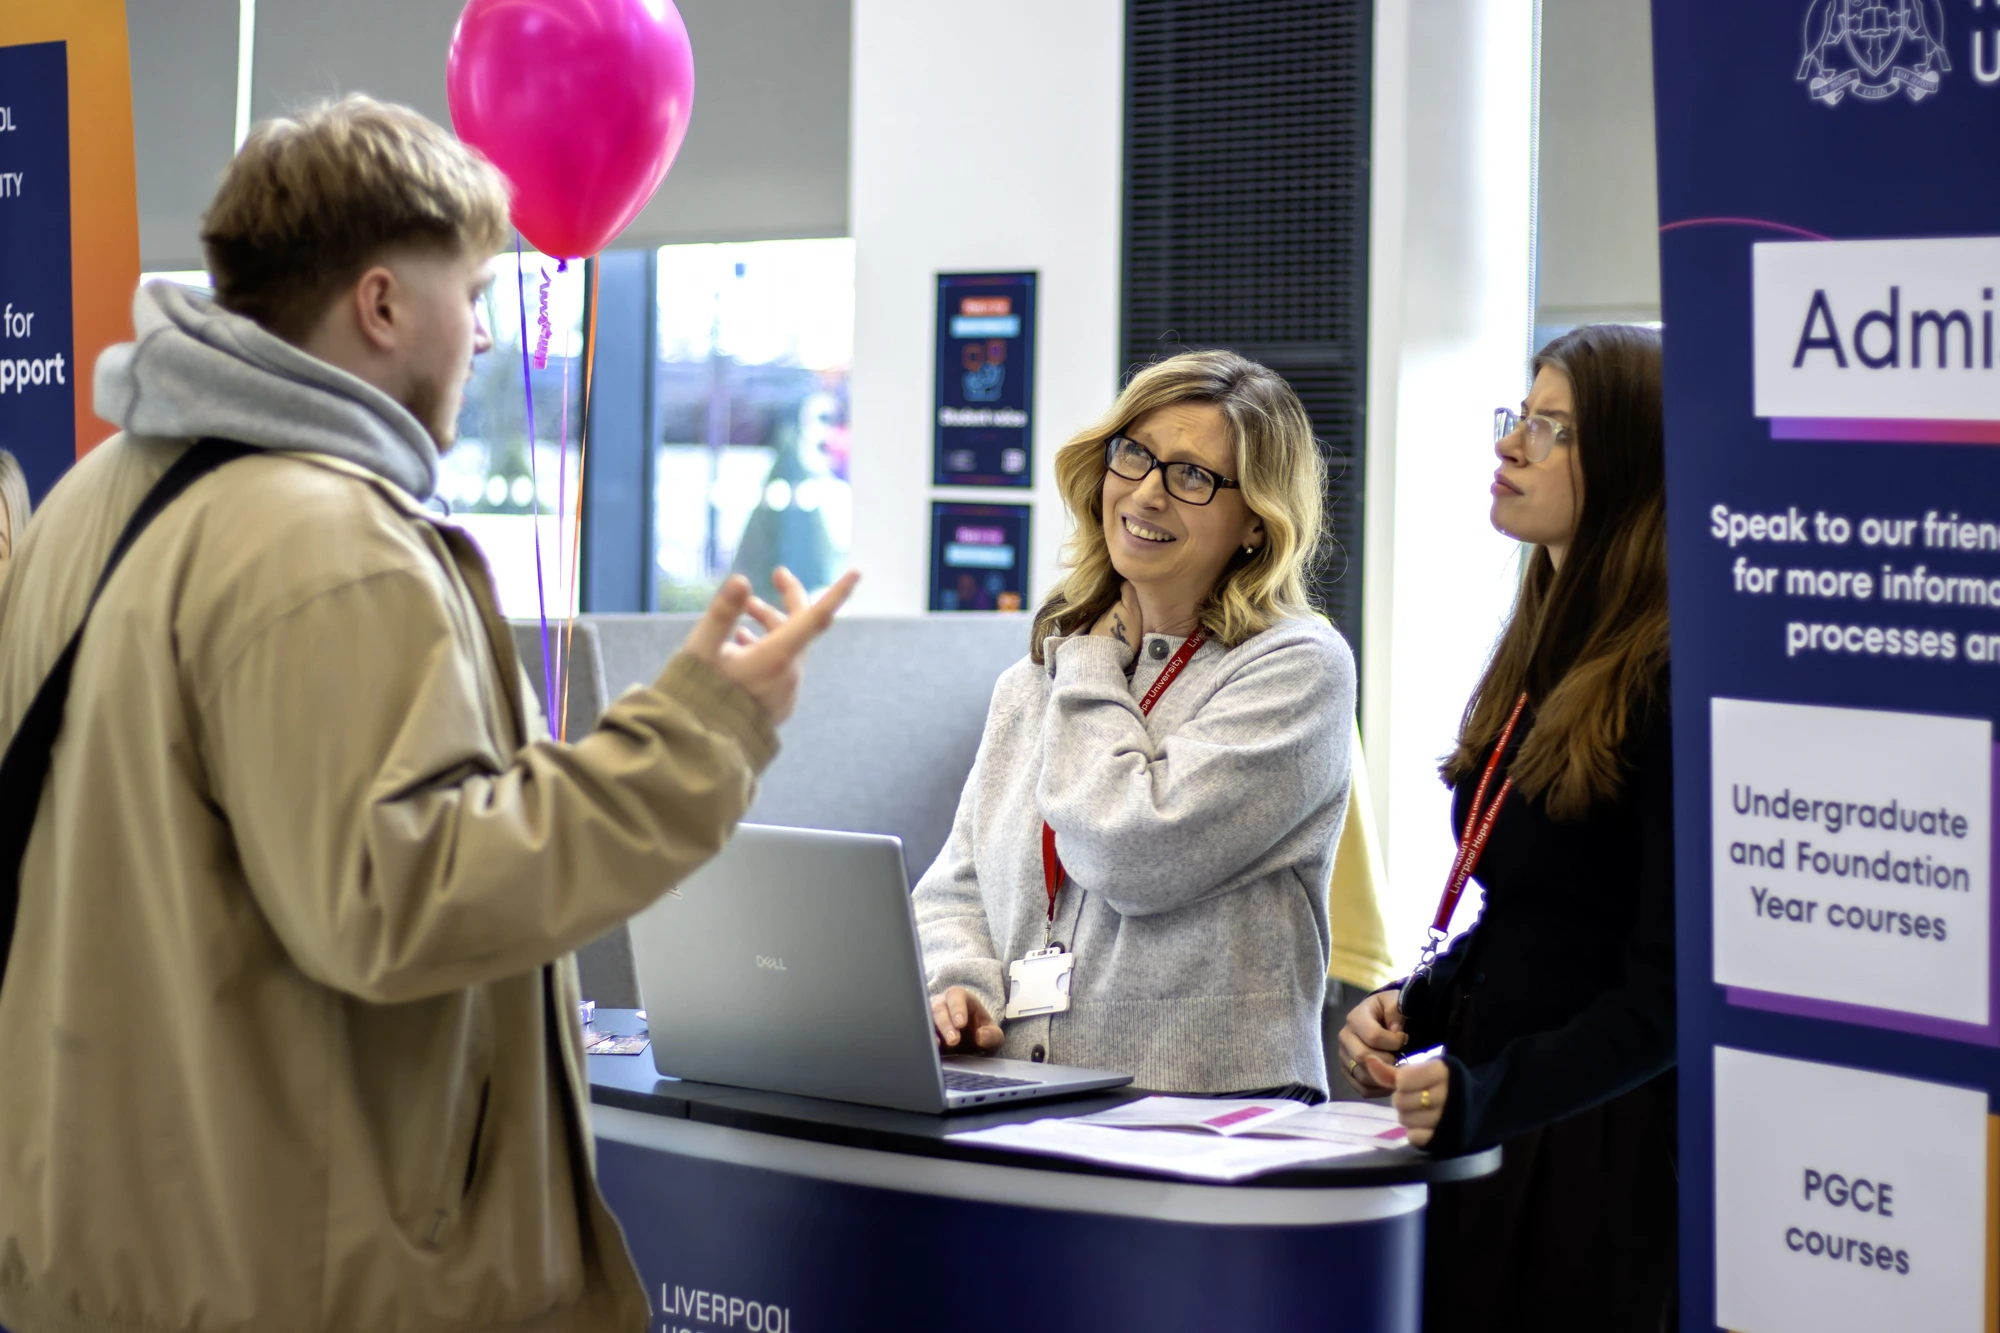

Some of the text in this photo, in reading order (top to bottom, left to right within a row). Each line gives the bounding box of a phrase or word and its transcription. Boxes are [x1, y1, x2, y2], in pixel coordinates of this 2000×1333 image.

[4, 302, 34, 338] for
[1711, 504, 2000, 550] Speak to our frien
[1733, 556, 1778, 593] for
[1786, 568, 1873, 598] more
[1787, 622, 1956, 658] processes
[1148, 656, 1184, 698] University
[1473, 766, 1494, 811] Liverpool
[1732, 783, 1968, 839] Undergraduate
[1450, 775, 1513, 894] Liverpool Hope Universit
[1463, 812, 1477, 839] Hope
[1729, 838, 1970, 892] and Foundation
[1750, 885, 1947, 942] Year courses
[756, 954, 787, 970] DELL
[1804, 1168, 1893, 1218] PGCE
[1785, 1227, 1910, 1275] courses
[662, 1282, 790, 1333] LIVERPOOL
